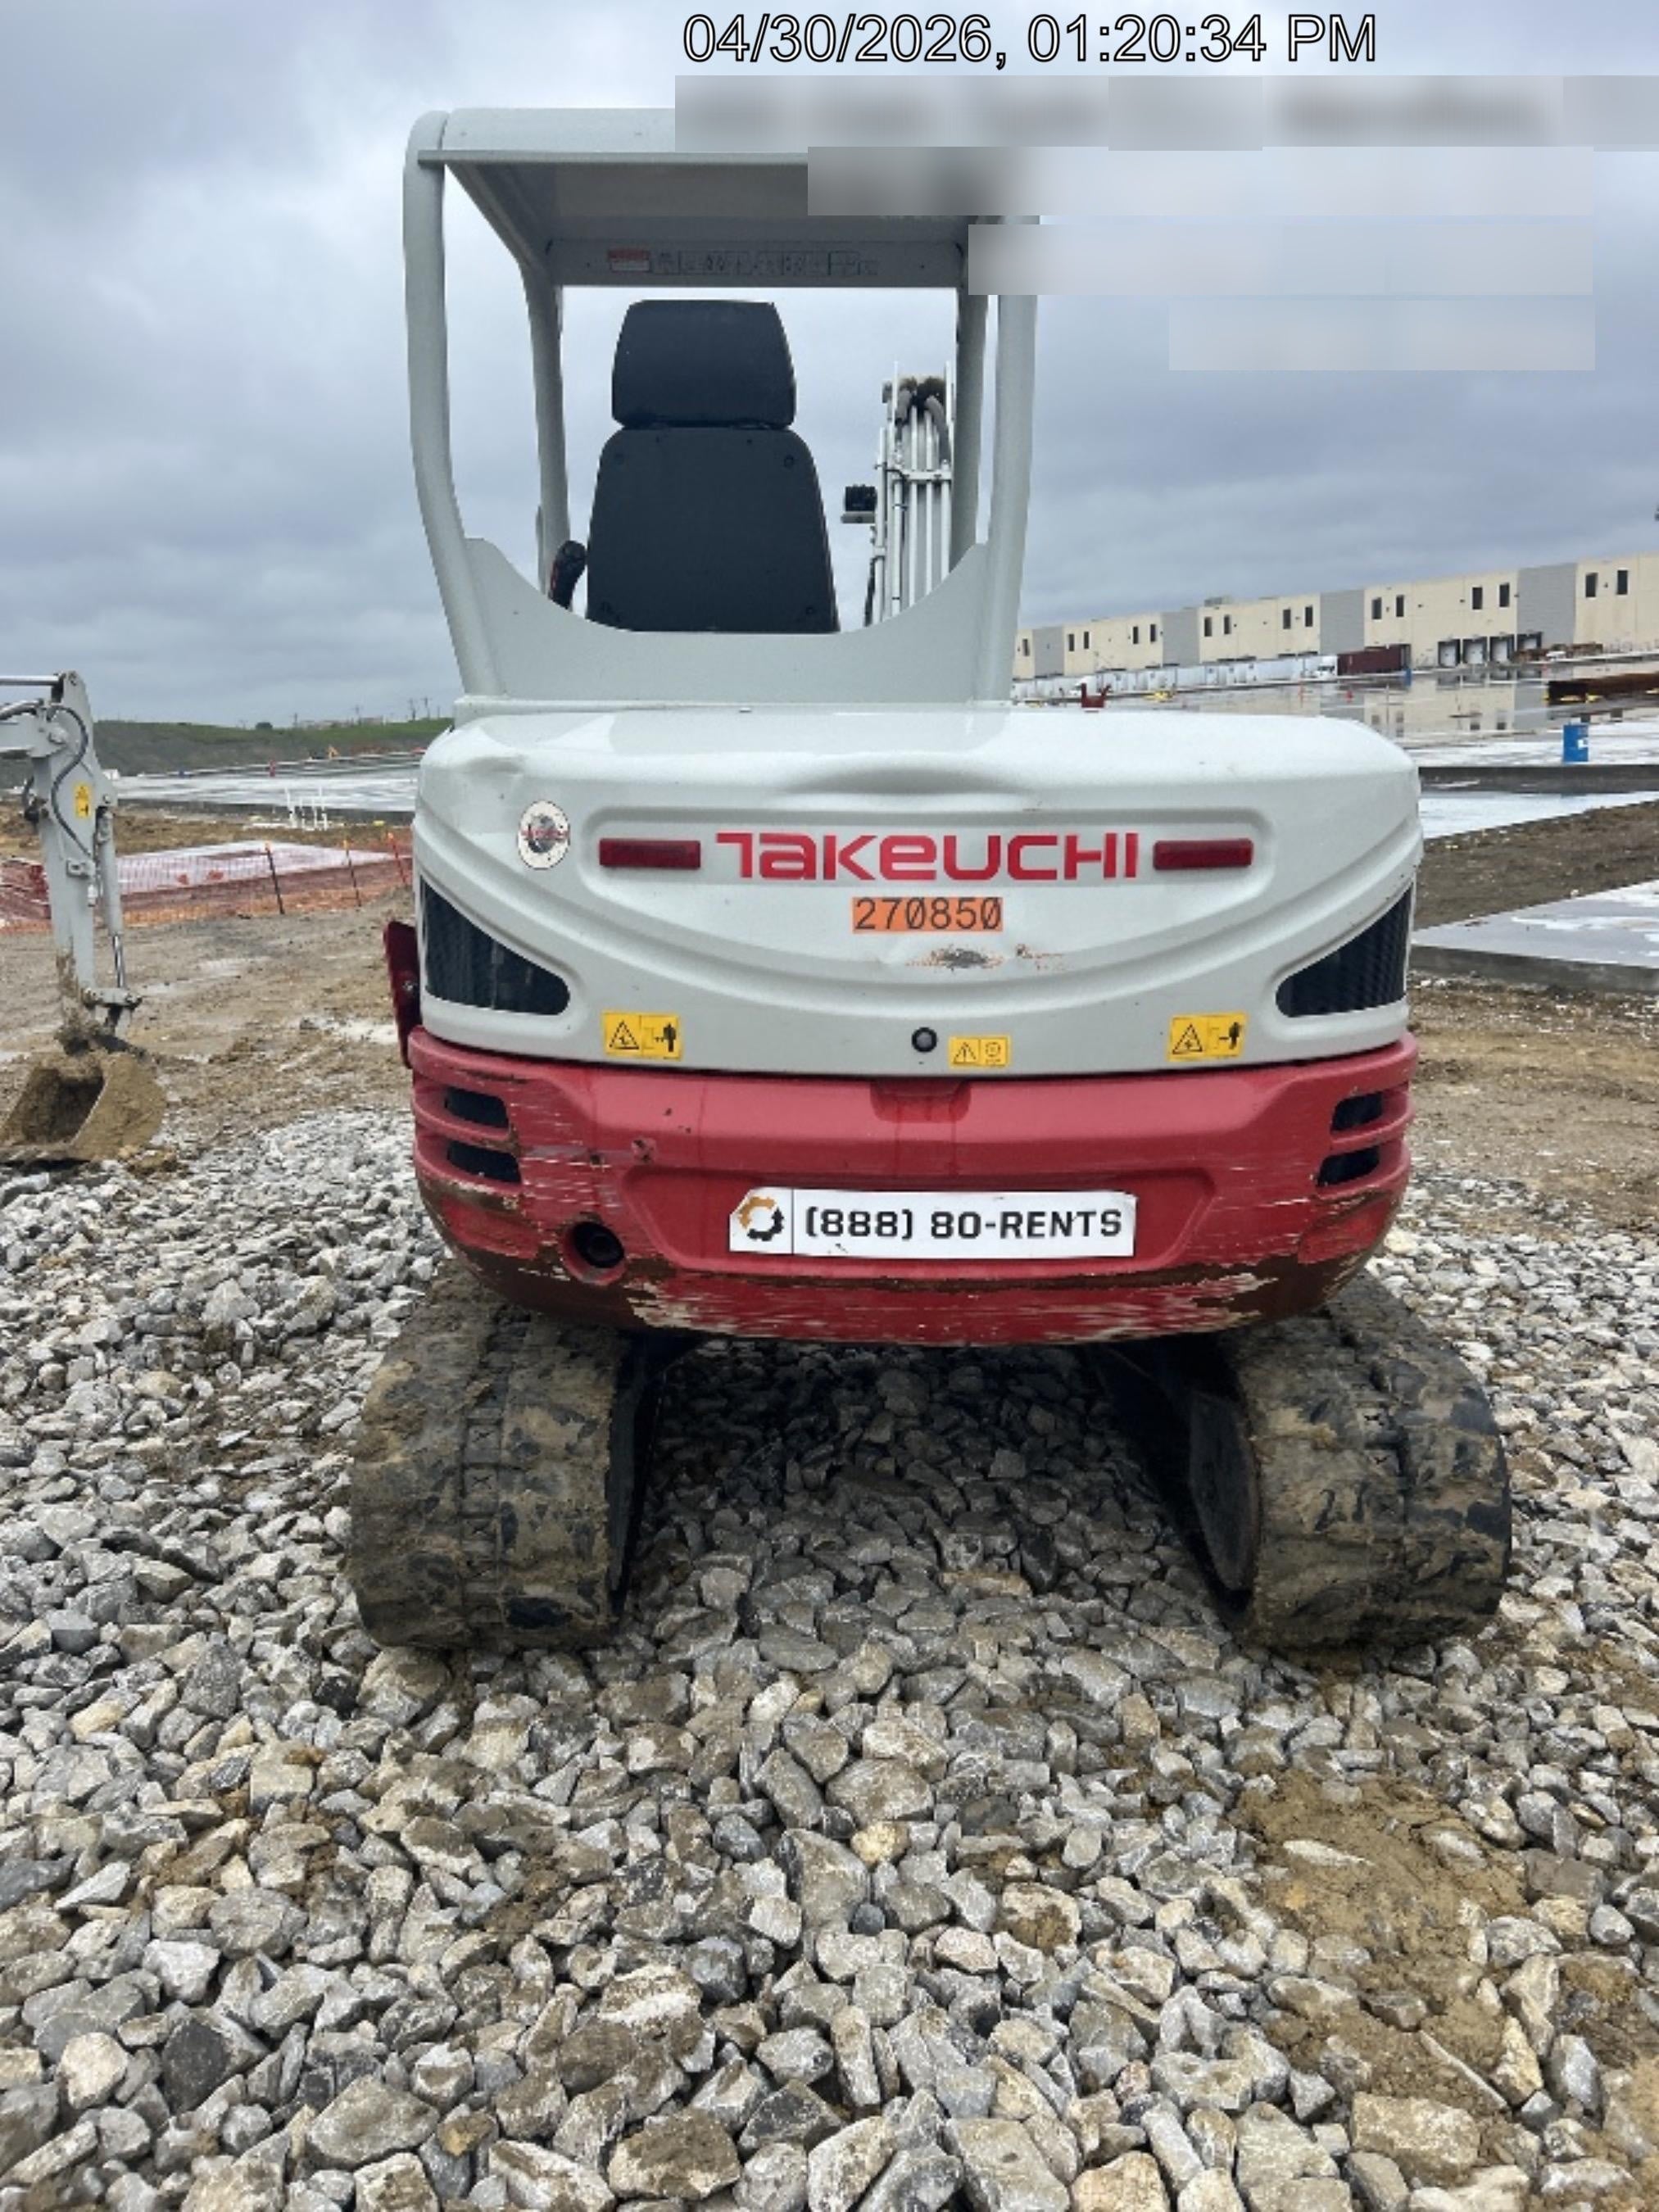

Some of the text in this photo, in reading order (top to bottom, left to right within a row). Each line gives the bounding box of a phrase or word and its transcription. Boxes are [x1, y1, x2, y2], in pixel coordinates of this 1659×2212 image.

[854, 897, 1002, 930] 270850
[805, 1206, 1122, 1240] (888) 80-RENTS
